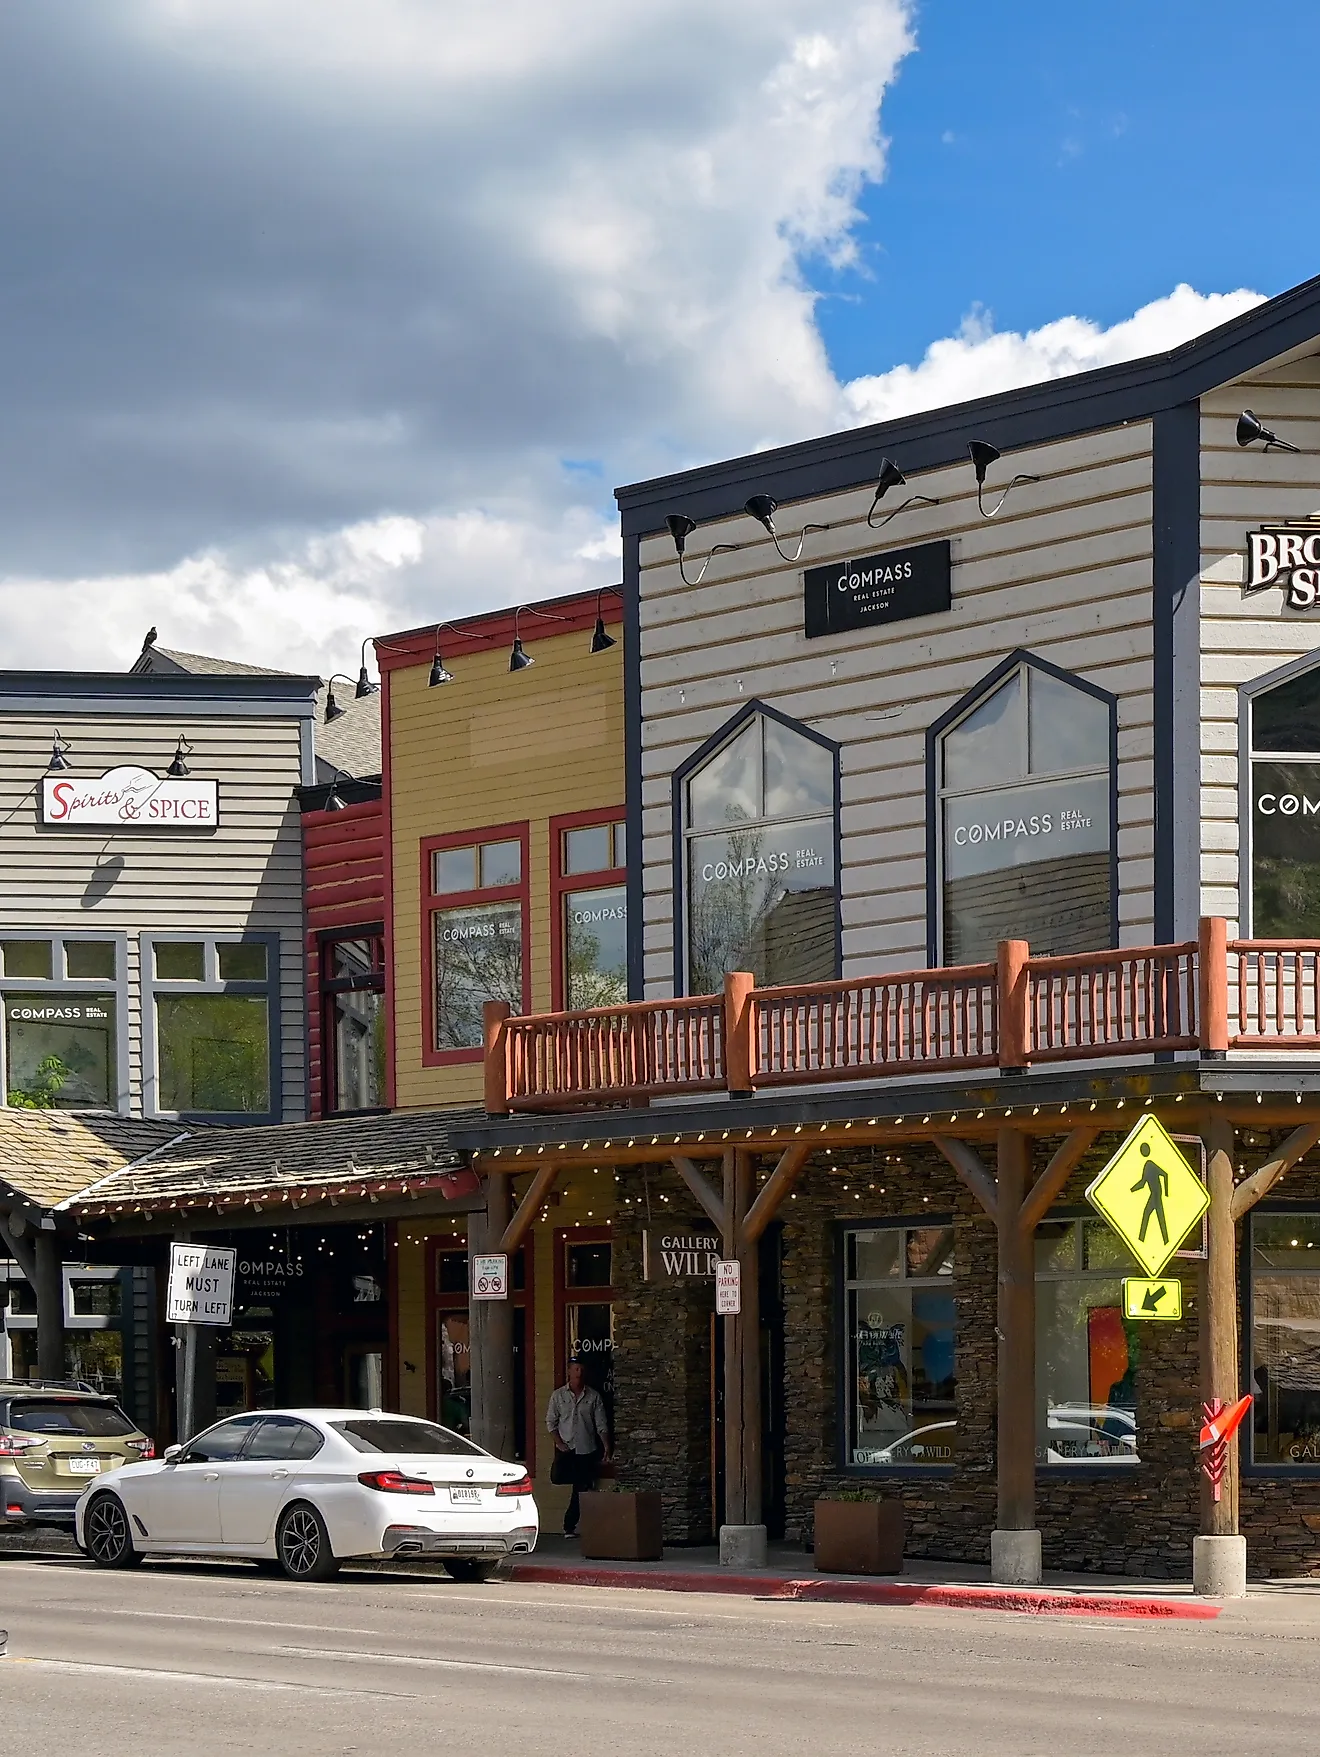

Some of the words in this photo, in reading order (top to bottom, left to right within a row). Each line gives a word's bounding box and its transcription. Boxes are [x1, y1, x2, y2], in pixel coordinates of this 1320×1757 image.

[838, 561, 912, 592] COMPASS
[853, 592, 869, 602] REAL
[872, 587, 895, 598] ESTATE
[860, 601, 890, 613] JACKSON
[50, 782, 120, 820] Spirits
[118, 797, 141, 820] &
[149, 799, 211, 819] SPICE
[1061, 809, 1083, 820] REAL
[954, 813, 1053, 846] COMPASS
[1061, 818, 1091, 831] ESTATE
[796, 848, 815, 858] REAL
[702, 852, 789, 881] COMPASS
[796, 857, 823, 868] ESTATE
[443, 923, 495, 942] COMPASS
[10, 1008, 81, 1019] COMPASS
[661, 1236, 719, 1250] GALLERY
[178, 1254, 200, 1268] LEFT
[205, 1257, 230, 1271] LANE
[239, 1261, 304, 1277] OMPASS
[723, 1264, 733, 1275] NO
[185, 1277, 220, 1293] MUST
[718, 1277, 739, 1287] PARKING
[174, 1299, 198, 1313] TURN
[204, 1302, 228, 1315] LEFT
[925, 1445, 952, 1458] WILD
